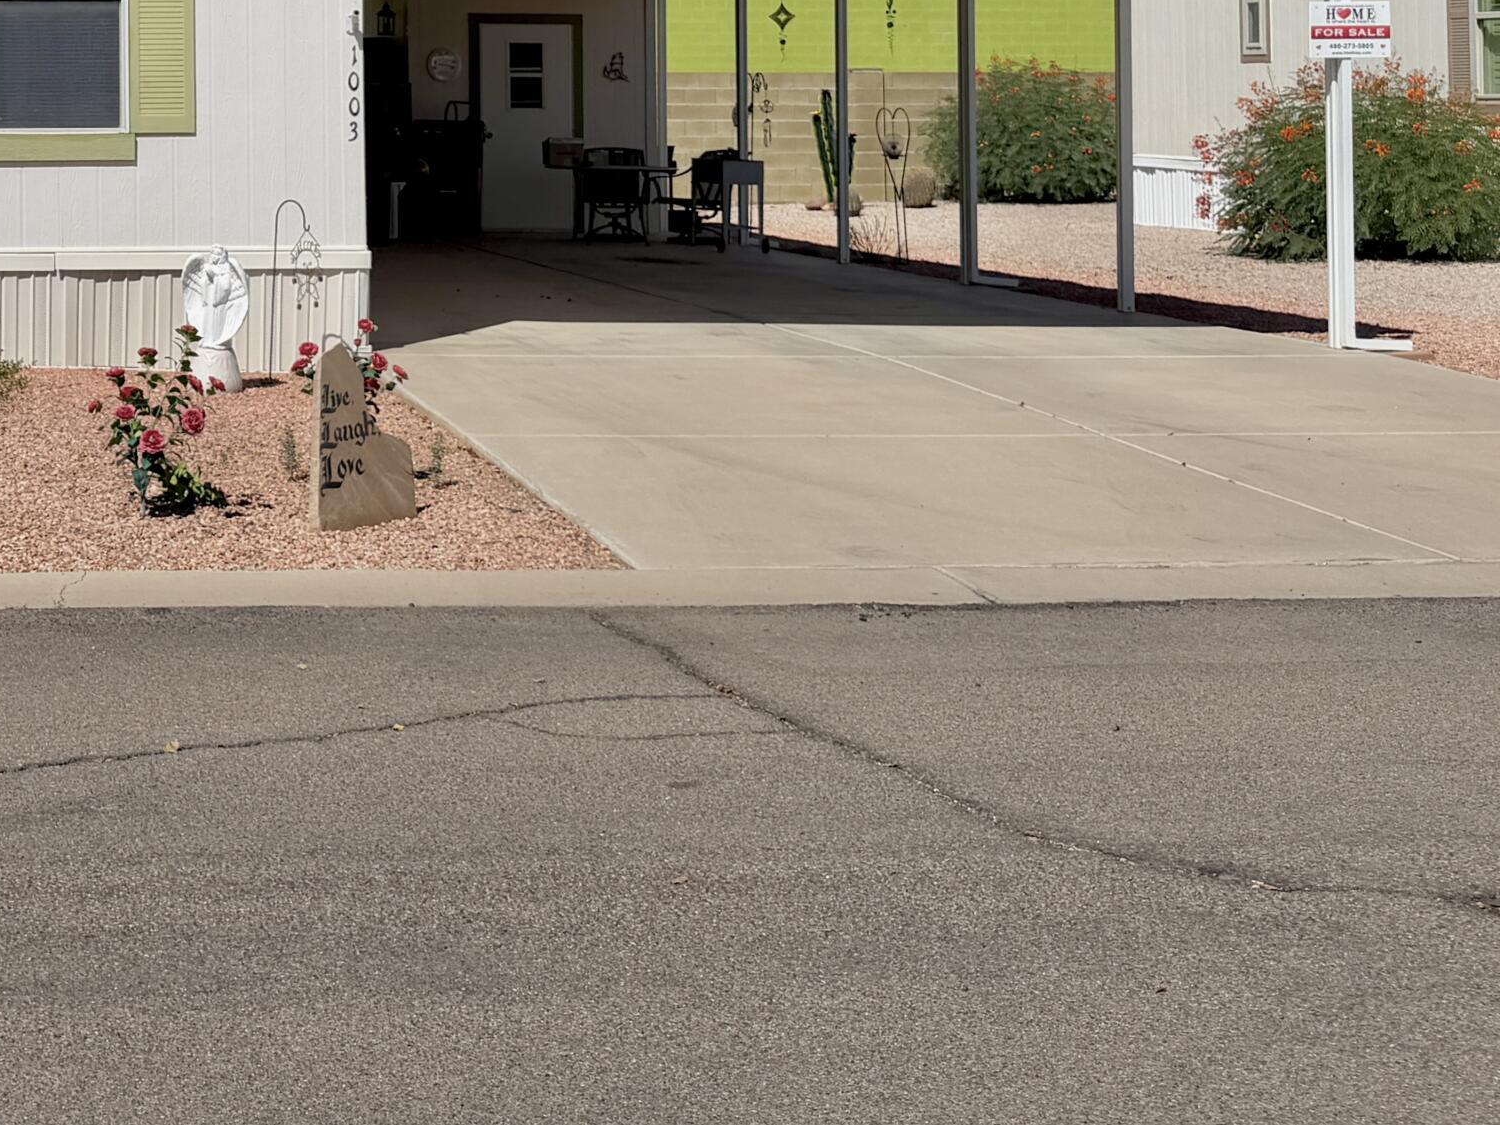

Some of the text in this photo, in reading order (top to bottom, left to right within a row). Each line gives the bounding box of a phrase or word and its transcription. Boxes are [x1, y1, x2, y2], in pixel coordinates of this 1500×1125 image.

[1315, 28, 1385, 36] FOR SALE
[348, 45, 360, 142] 1003
[320, 454, 365, 497] Love
